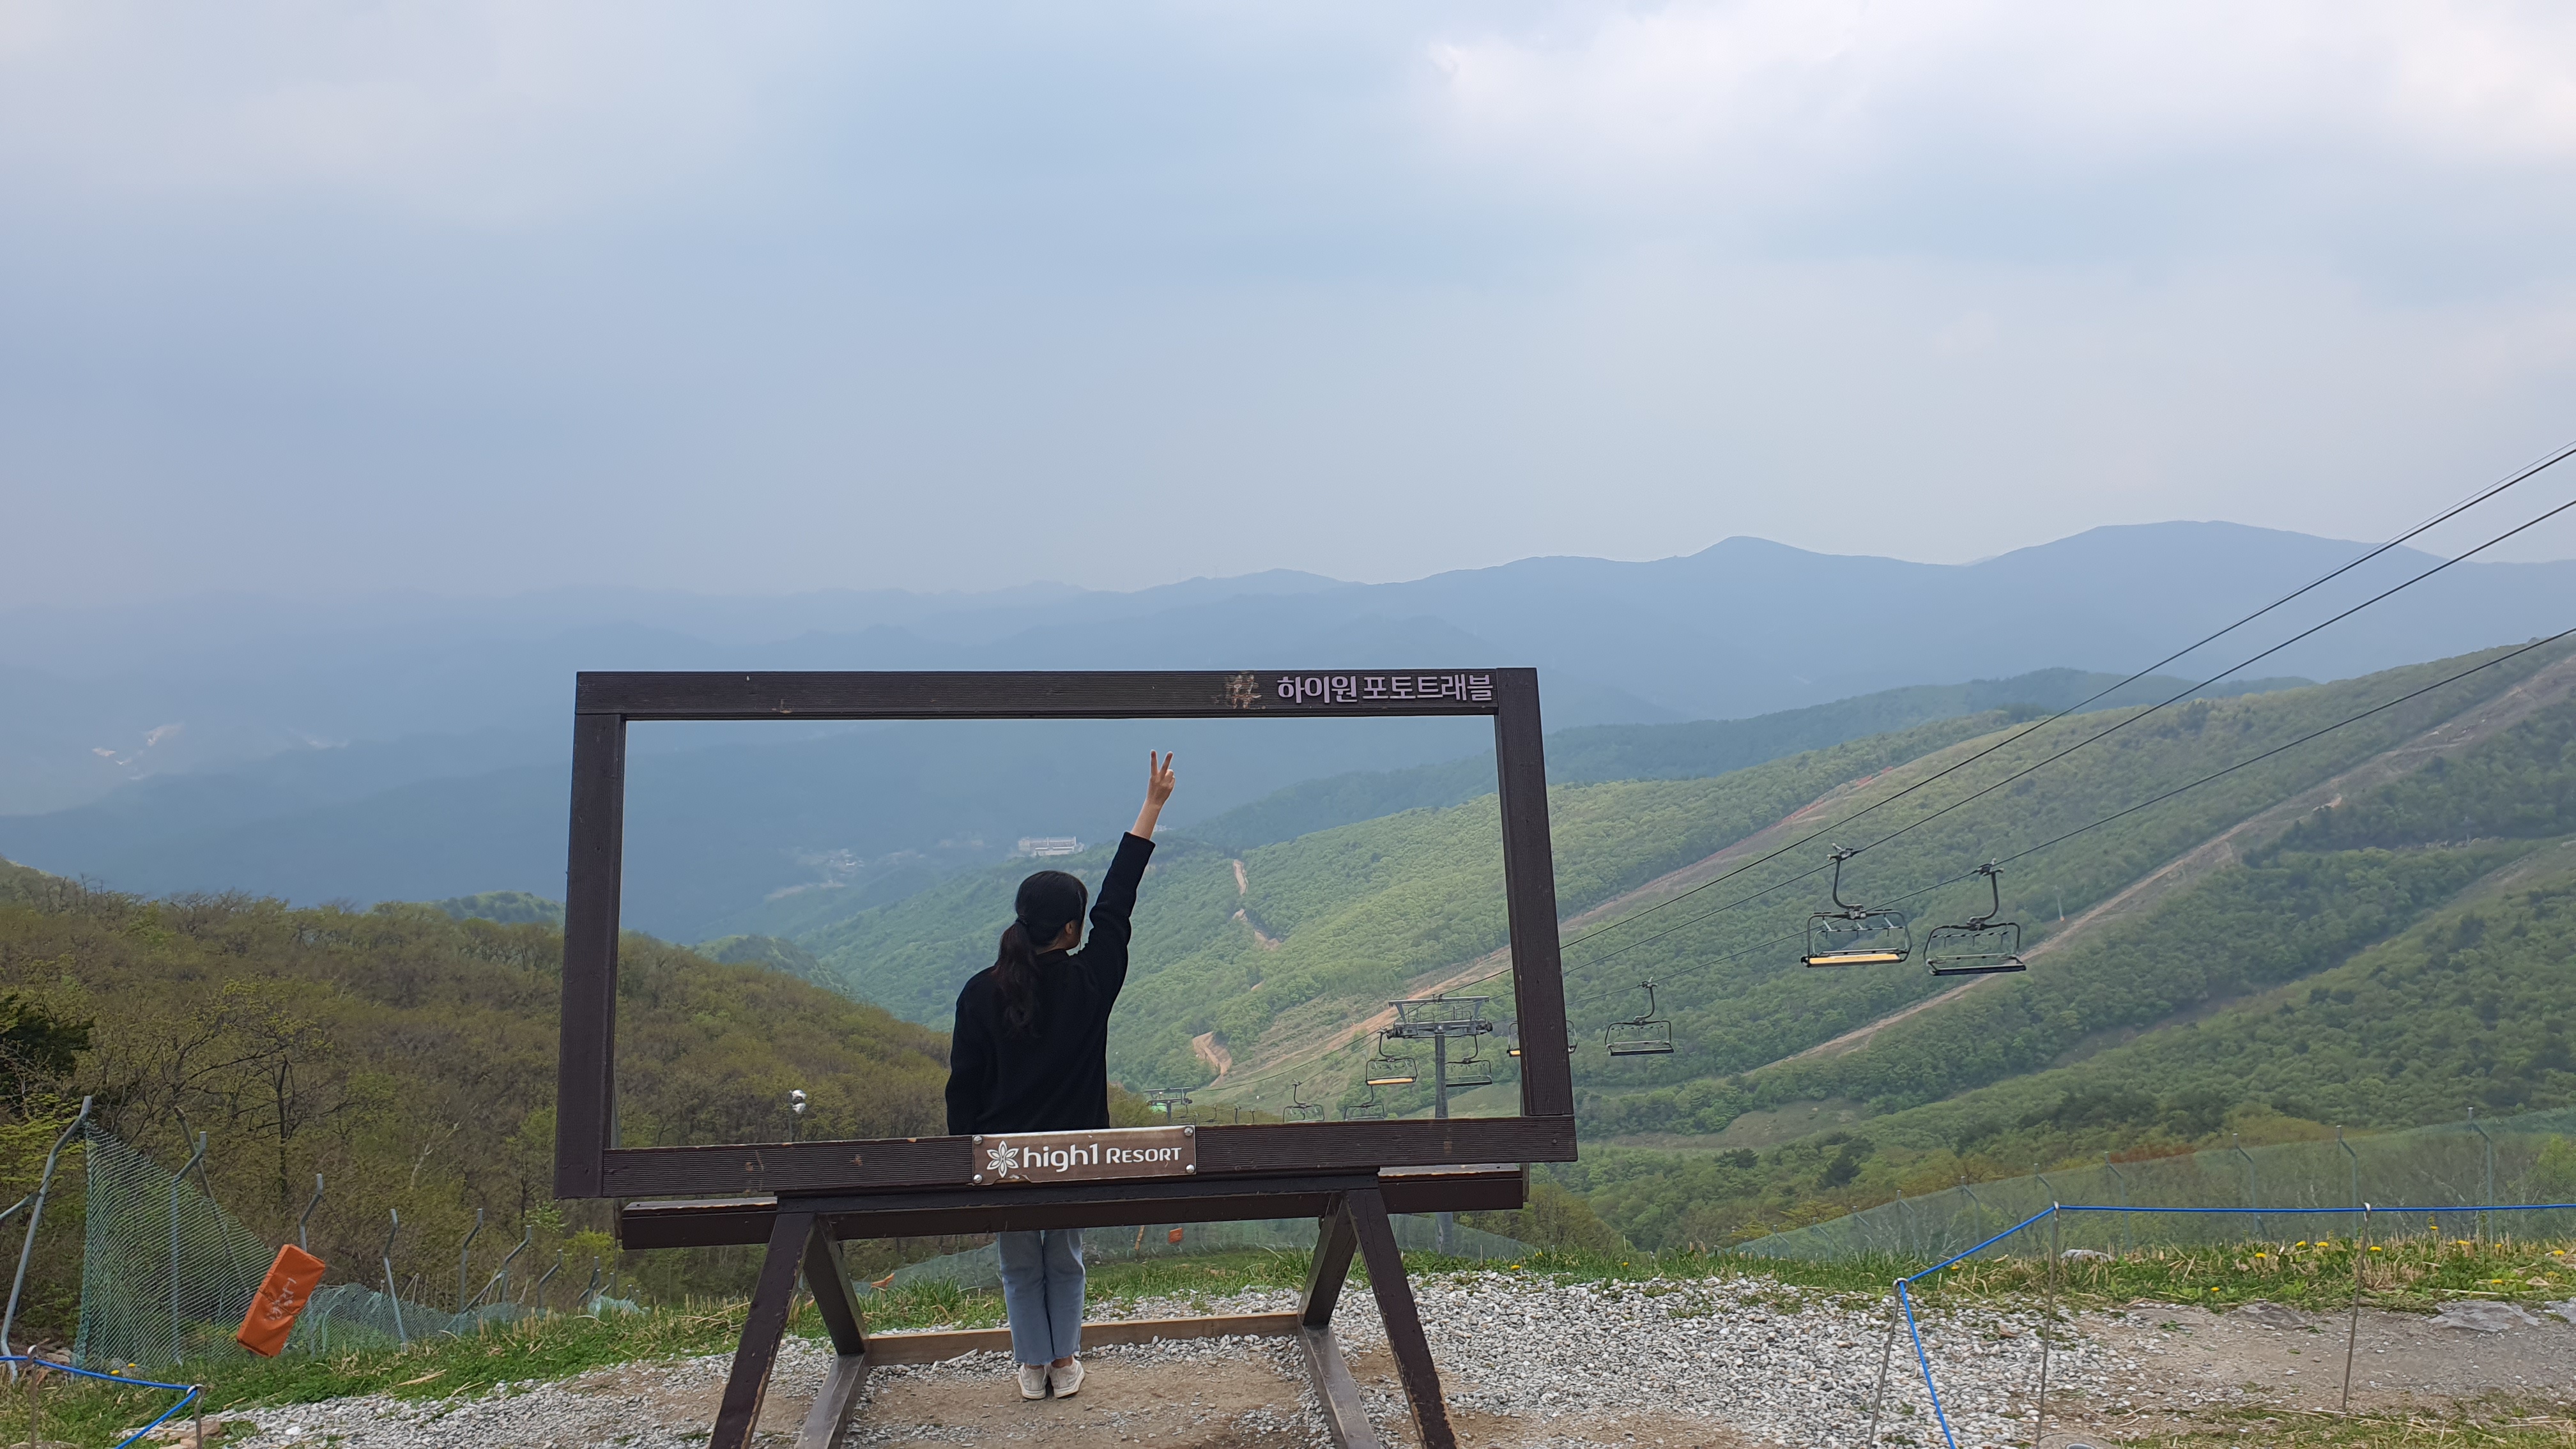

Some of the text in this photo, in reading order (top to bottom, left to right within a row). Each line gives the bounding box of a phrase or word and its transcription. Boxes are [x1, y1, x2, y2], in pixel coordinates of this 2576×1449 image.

[1278, 676, 1358, 703] 하이원
[1363, 674, 1493, 702] 포토트래블
[1023, 1144, 1182, 1172] high1 RESORT
